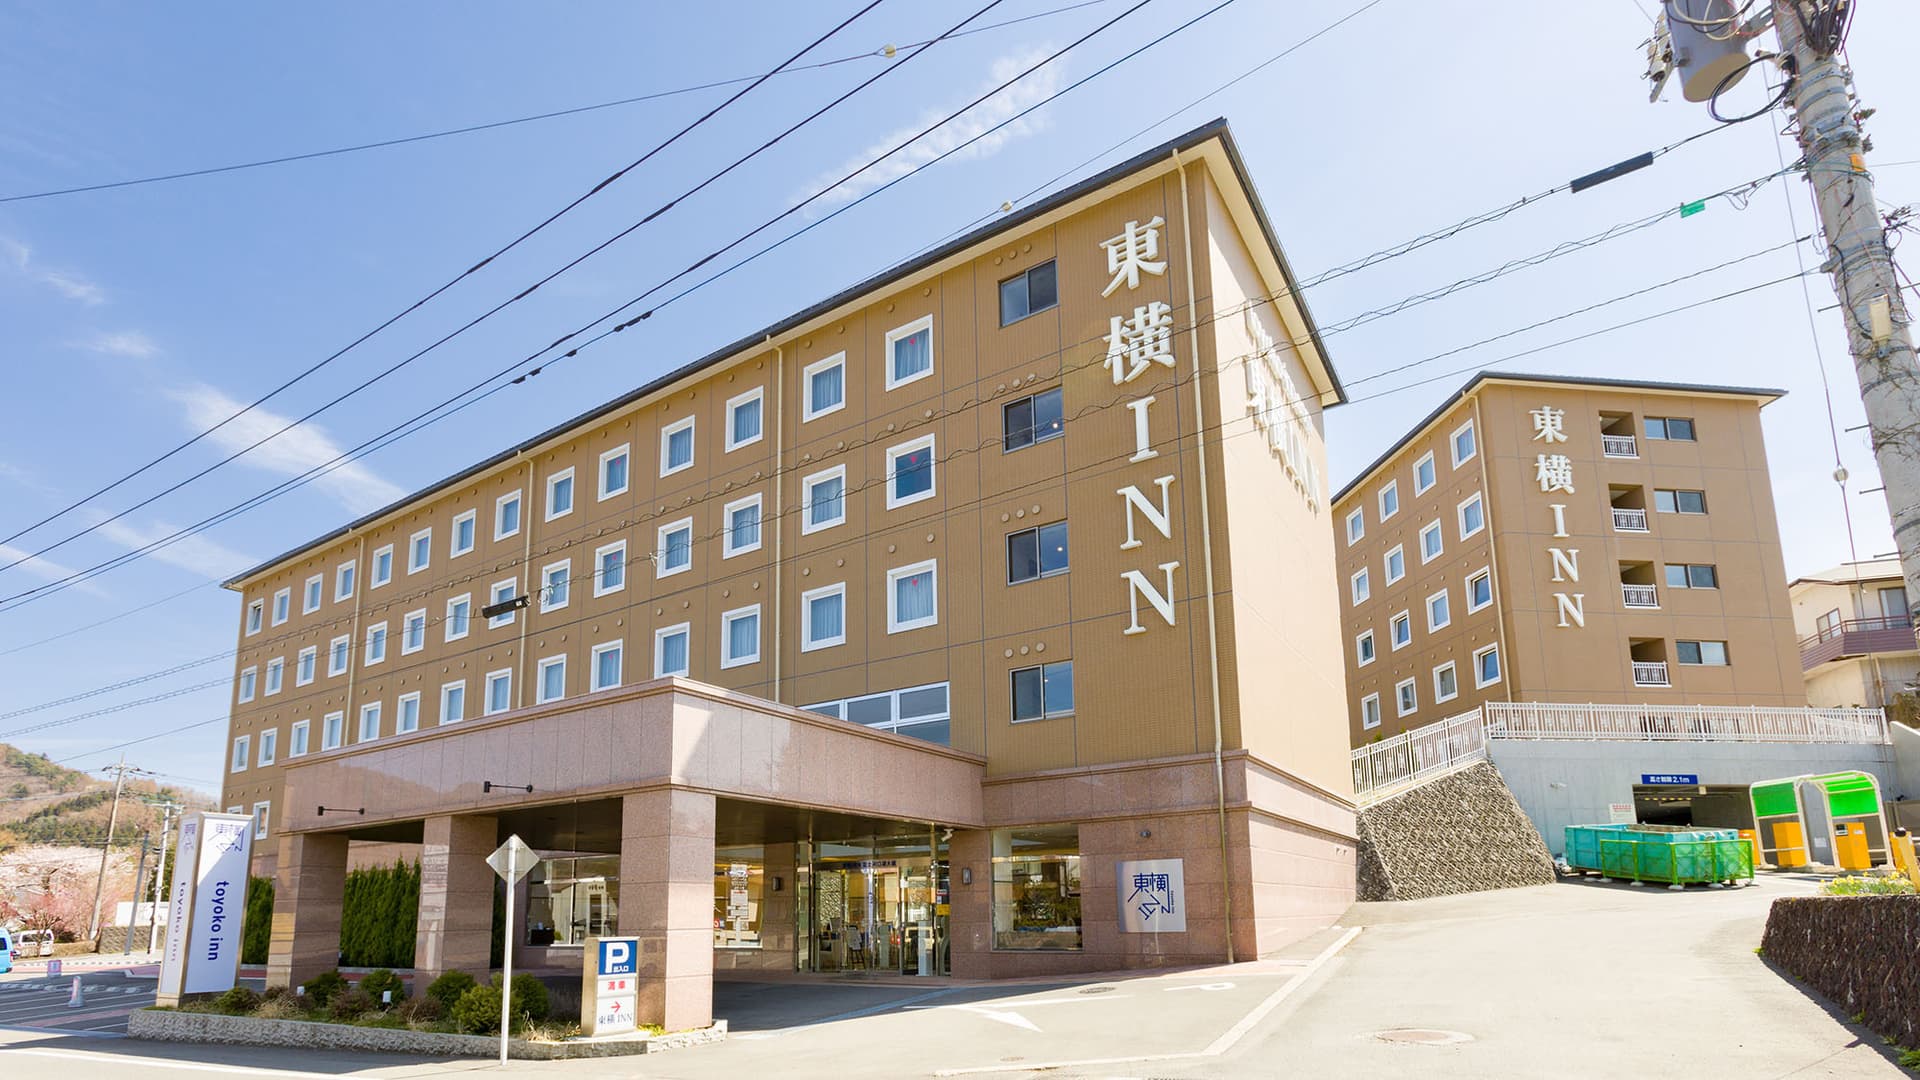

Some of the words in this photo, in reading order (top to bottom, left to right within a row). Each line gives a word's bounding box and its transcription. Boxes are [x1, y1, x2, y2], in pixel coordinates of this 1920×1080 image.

[1100, 216, 1179, 635] 東横INN
[1528, 406, 1585, 627] 東横INN
[210, 880, 229, 933] toyoko
[207, 937, 224, 961] inn
[605, 942, 630, 974] P
